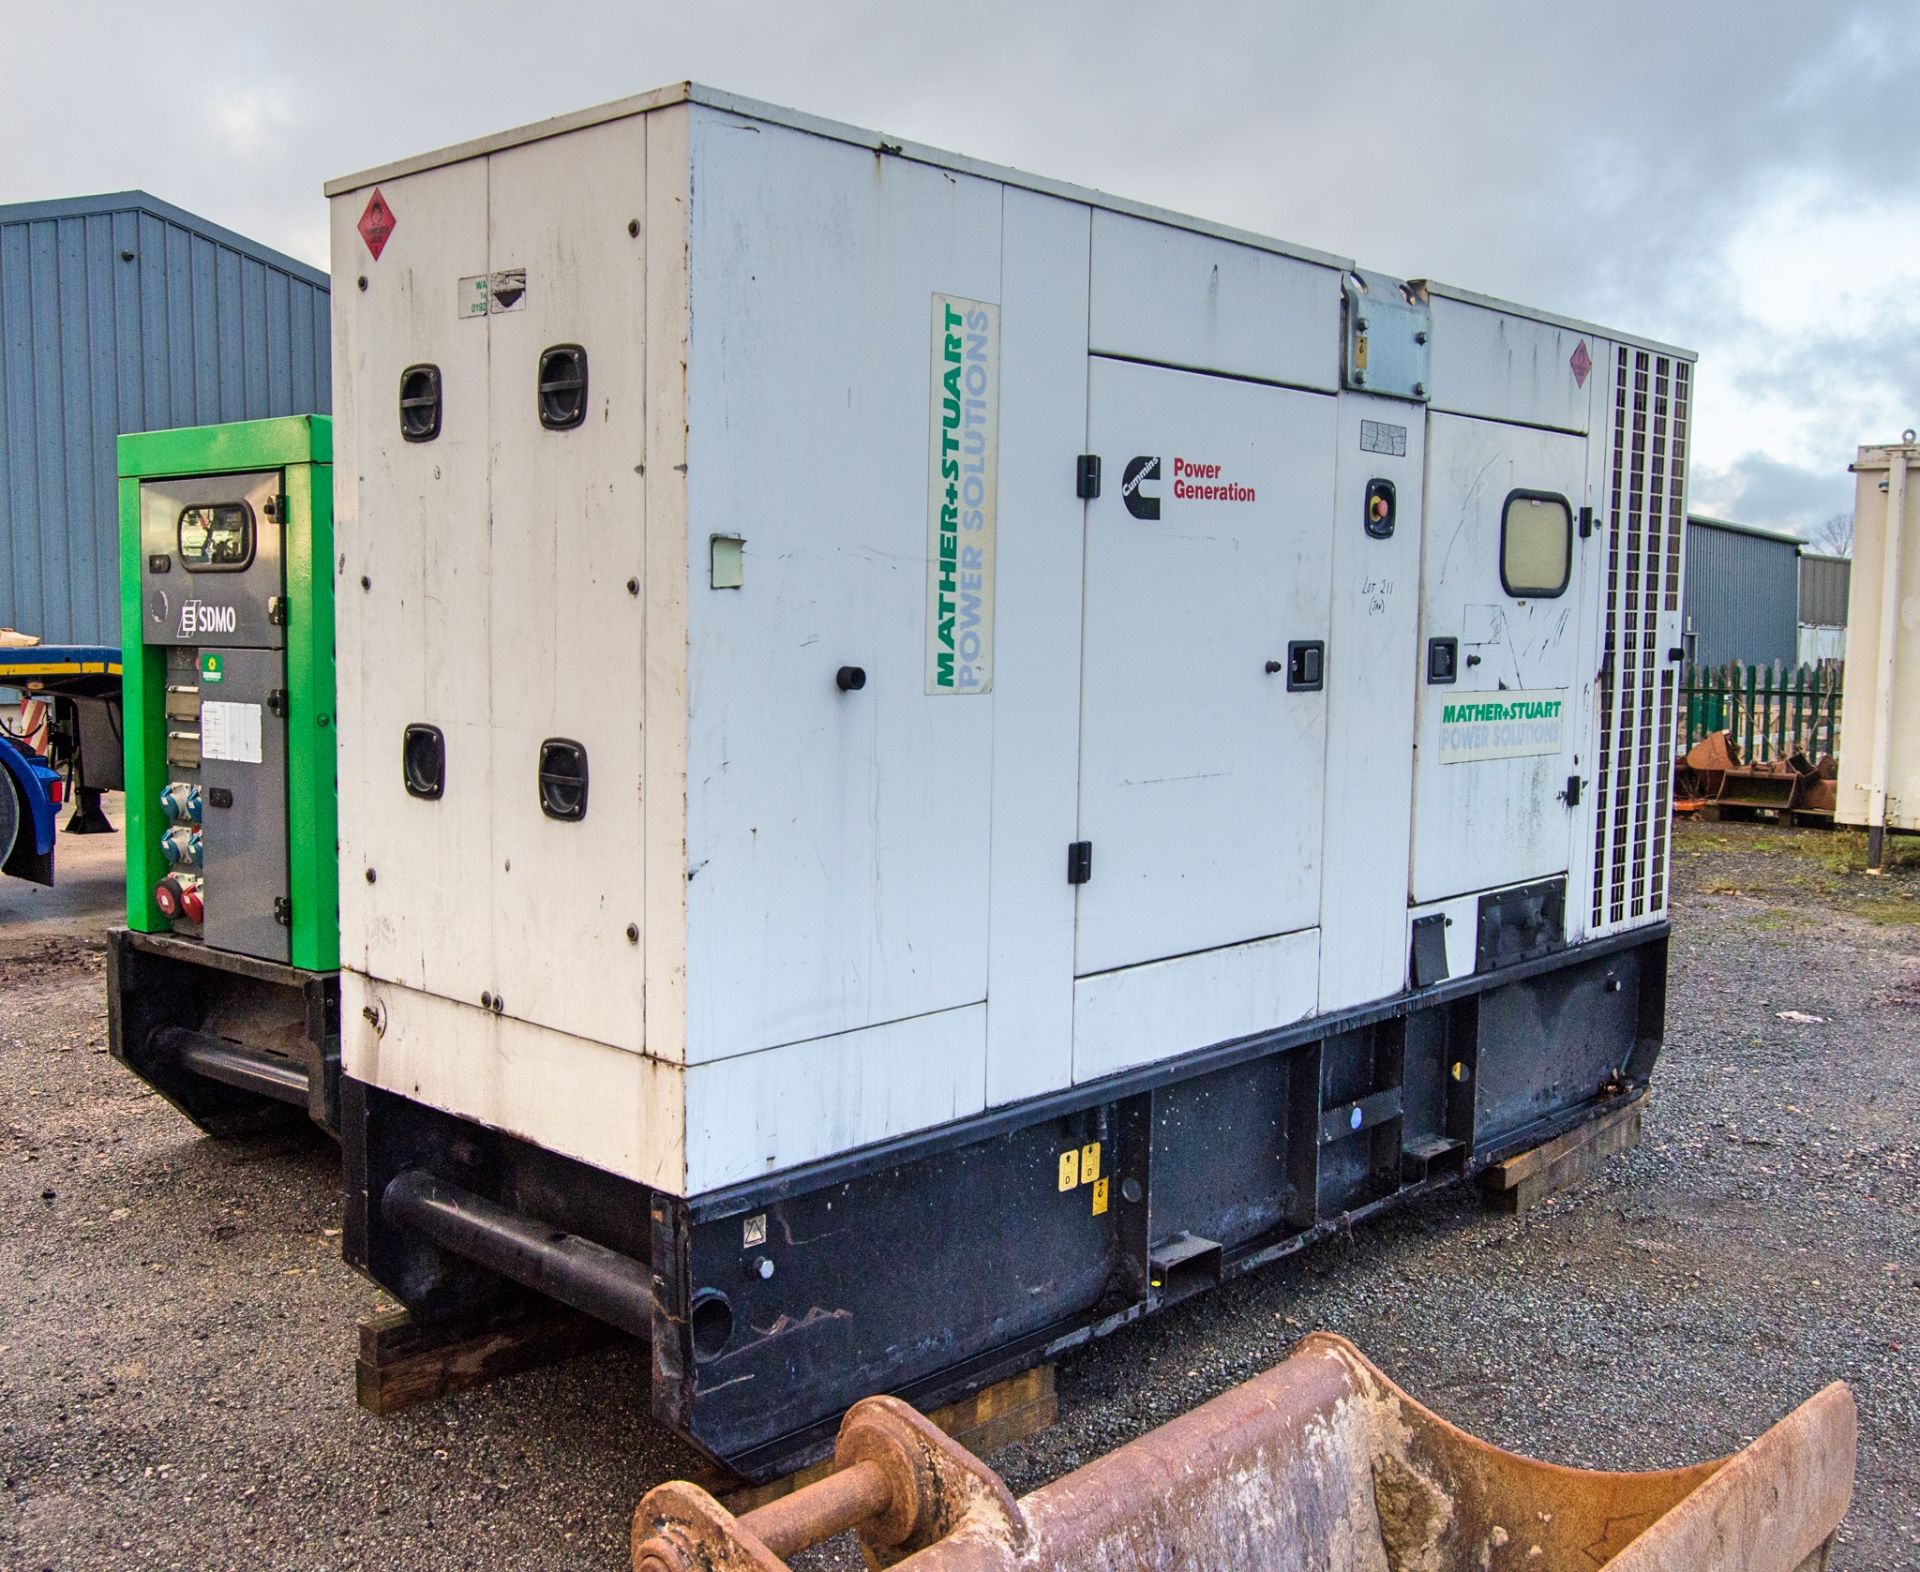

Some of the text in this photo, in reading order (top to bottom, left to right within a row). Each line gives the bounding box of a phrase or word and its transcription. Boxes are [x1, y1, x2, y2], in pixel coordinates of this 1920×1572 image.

[1122, 456, 1160, 497] Cummins
[1173, 457, 1221, 478] Power
[937, 303, 962, 688] MATHER+STUART
[958, 309, 989, 688] POWER SOLUTIONS
[1173, 479, 1256, 502] Generation
[1380, 579, 1394, 595] 211
[199, 606, 236, 632] SDMO
[1443, 701, 1561, 723] MATHER+STUART
[1442, 722, 1559, 751] POWER SOLUTIONS
